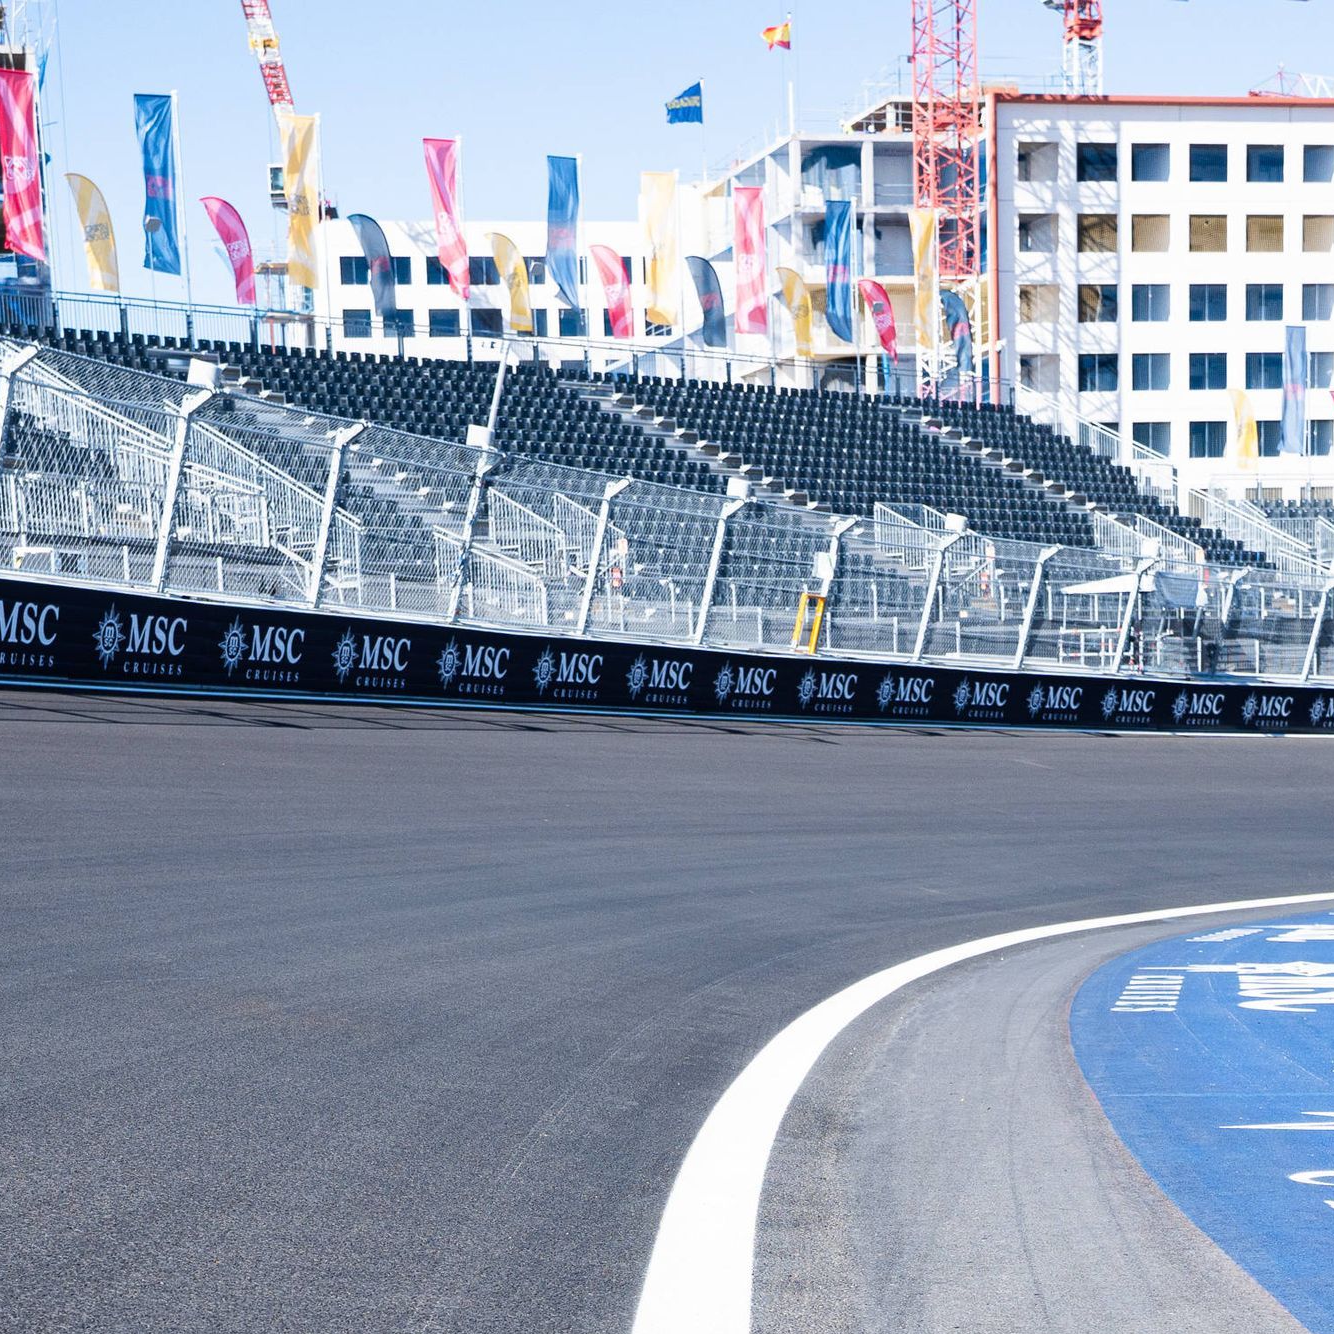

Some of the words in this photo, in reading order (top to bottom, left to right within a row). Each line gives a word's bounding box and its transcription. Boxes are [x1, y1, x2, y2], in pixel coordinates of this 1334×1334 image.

[126, 614, 187, 655] MSC
[249, 625, 304, 663] MSC
[359, 636, 411, 671] MSC
[461, 645, 510, 678] MSC
[124, 662, 181, 675] CRUISES
[245, 668, 300, 683] CRUISES
[556, 653, 603, 683] MSC
[649, 660, 692, 689] MSC
[355, 676, 406, 689] CRUISES
[458, 682, 504, 695] CRUISES
[735, 667, 776, 695] MSC
[817, 673, 857, 699] MSC
[895, 677, 934, 702] MSC
[553, 688, 598, 700] CRUISES
[645, 693, 688, 705] CRUISES
[731, 698, 772, 709] CRUISES
[971, 682, 1009, 706] MSC
[1045, 686, 1082, 709] MSC
[1119, 690, 1155, 712] MSC
[1189, 694, 1224, 714] MSC
[1259, 696, 1293, 716] MSC
